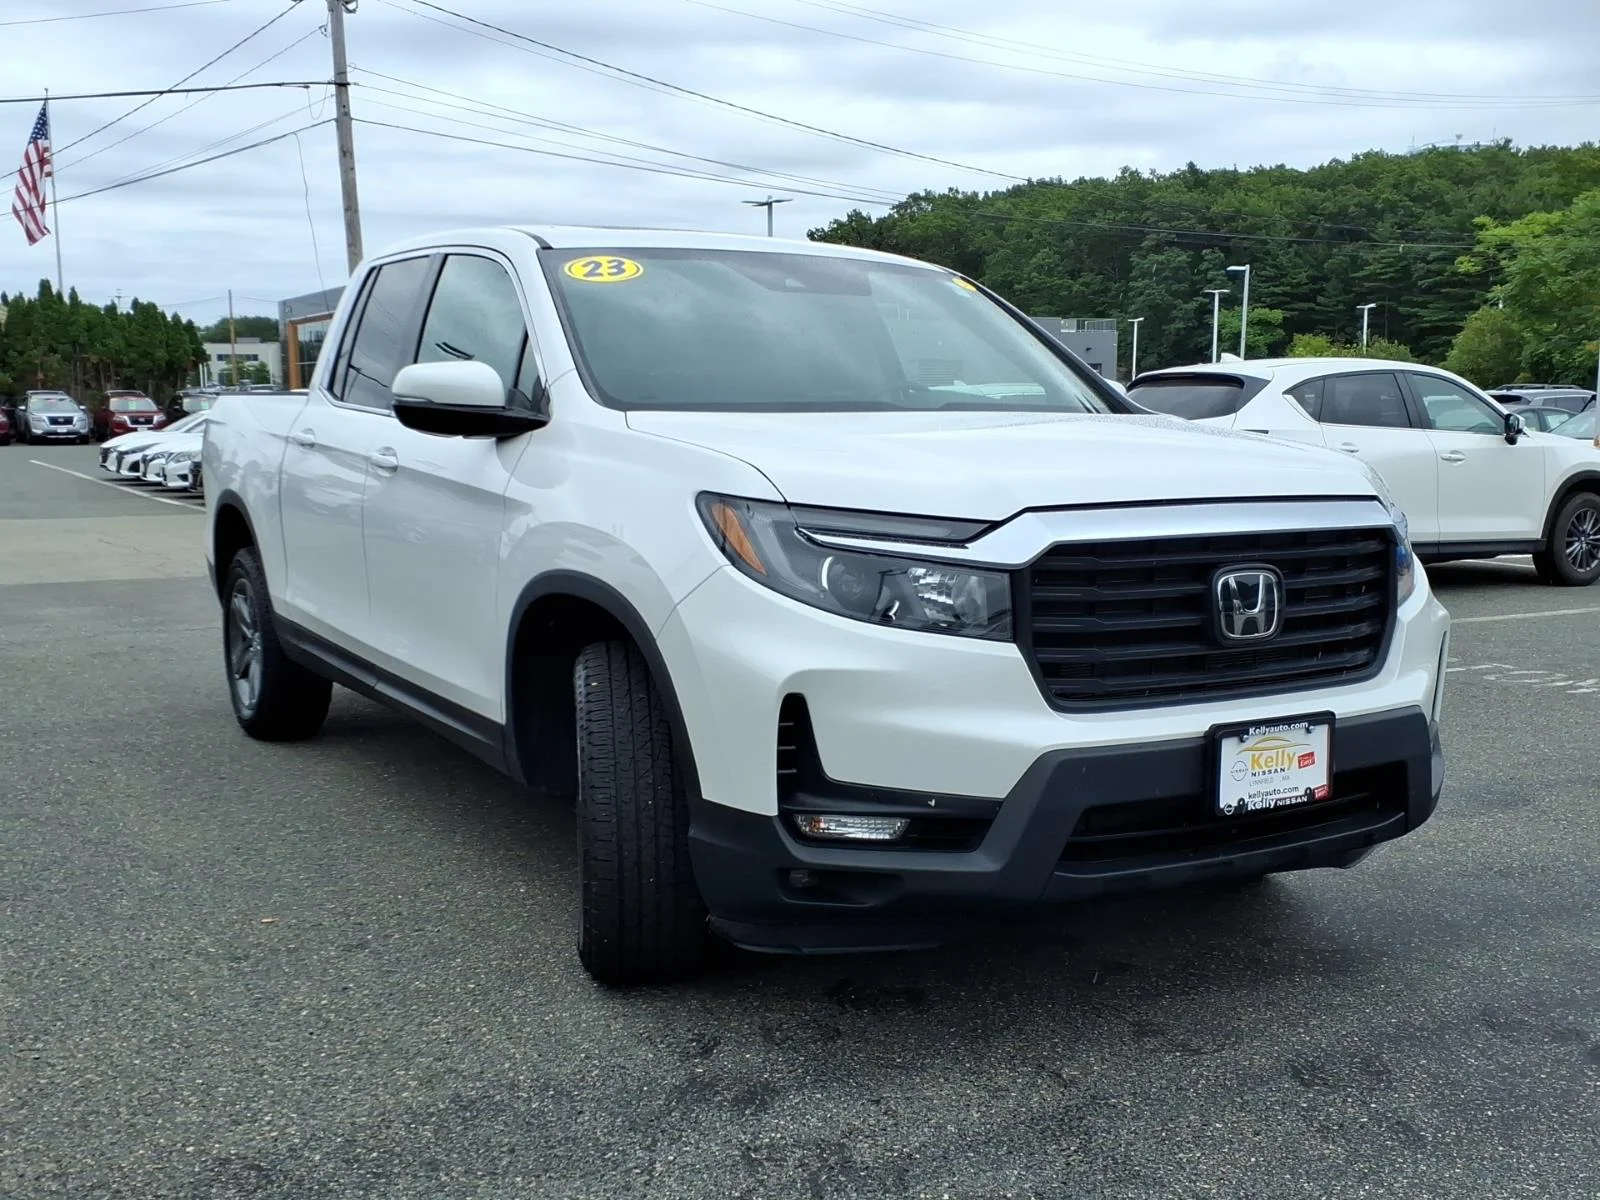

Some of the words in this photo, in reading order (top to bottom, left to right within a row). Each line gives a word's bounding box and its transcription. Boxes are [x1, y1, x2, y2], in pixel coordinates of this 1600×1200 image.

[581, 259, 626, 277] 23
[1249, 722, 1308, 735] Kellyauto.com
[1250, 751, 1296, 771] Kelly
[1251, 767, 1286, 777] NISSAN
[1248, 786, 1299, 800] kellyauto.com
[1247, 799, 1276, 811] Kelly
[1276, 796, 1308, 806] NISSAN
